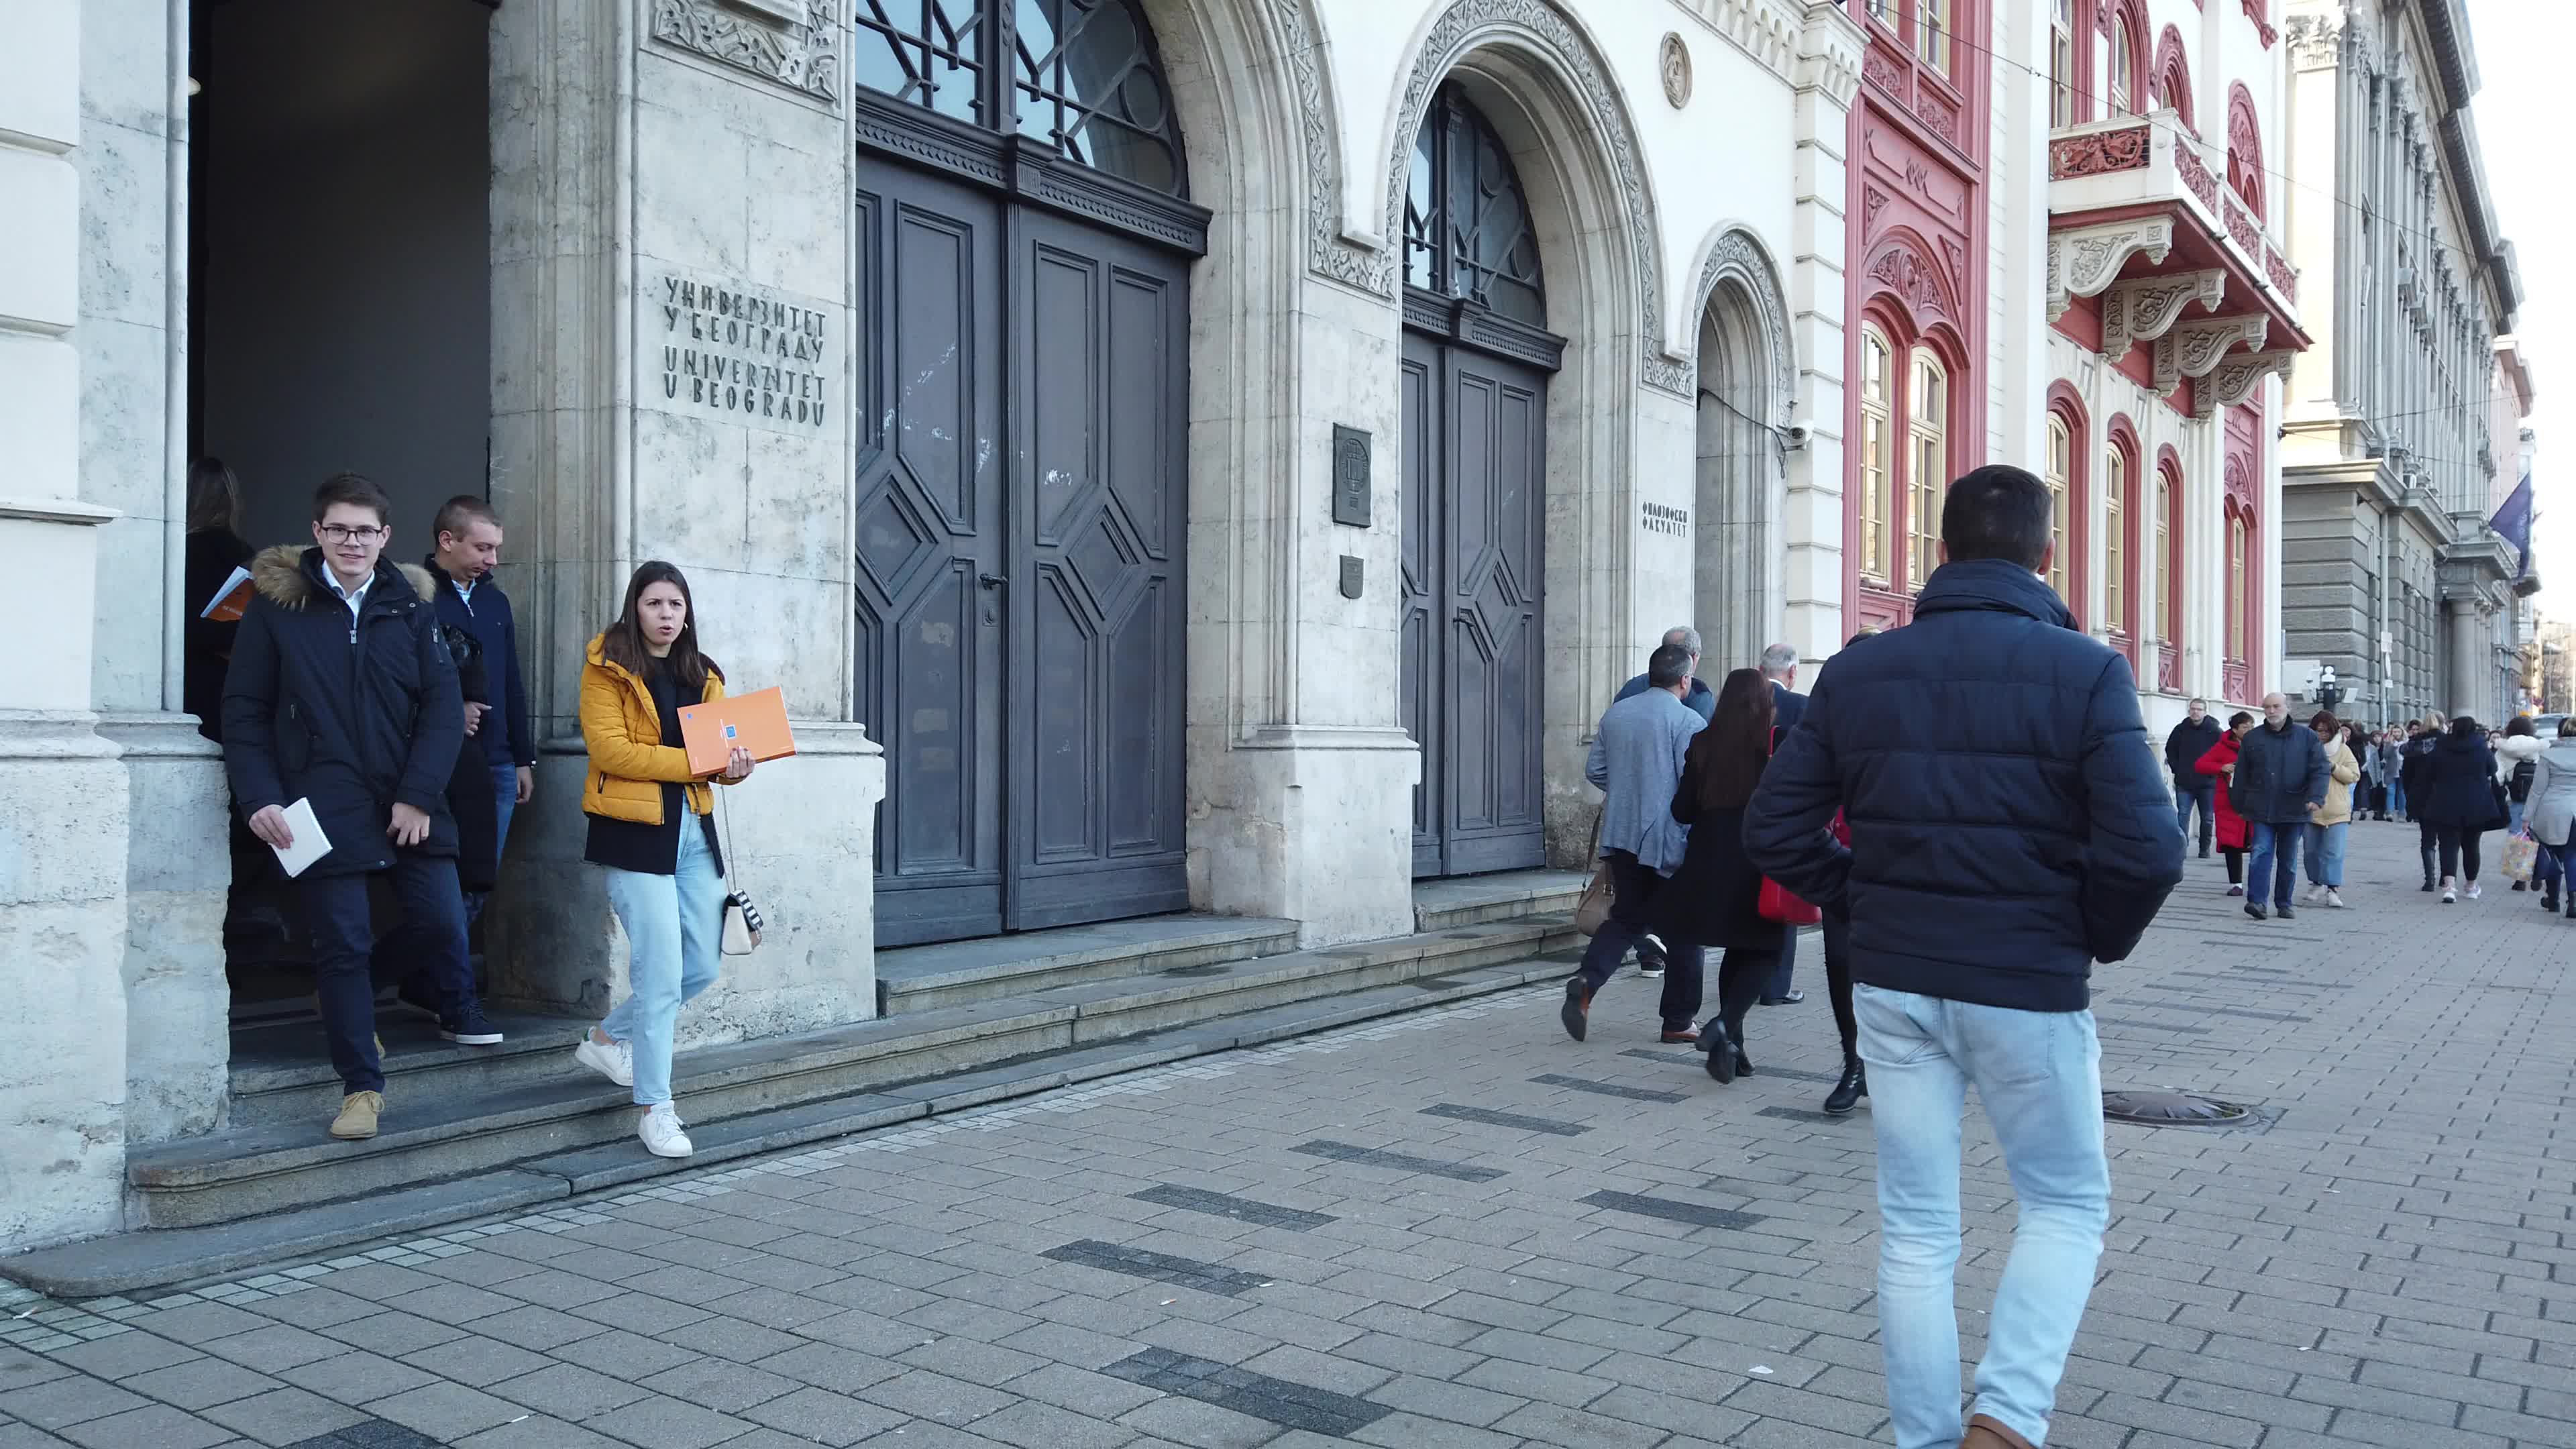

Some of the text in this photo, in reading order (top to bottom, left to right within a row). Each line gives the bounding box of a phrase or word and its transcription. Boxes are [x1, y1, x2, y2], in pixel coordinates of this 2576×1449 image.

[664, 305, 823, 364] У БЕОГРАДУ
[665, 276, 826, 337] УНИВЕРЗИТЕТ
[664, 373, 824, 427] U BEOGRADU
[665, 345, 825, 401] UNIVERZITET
